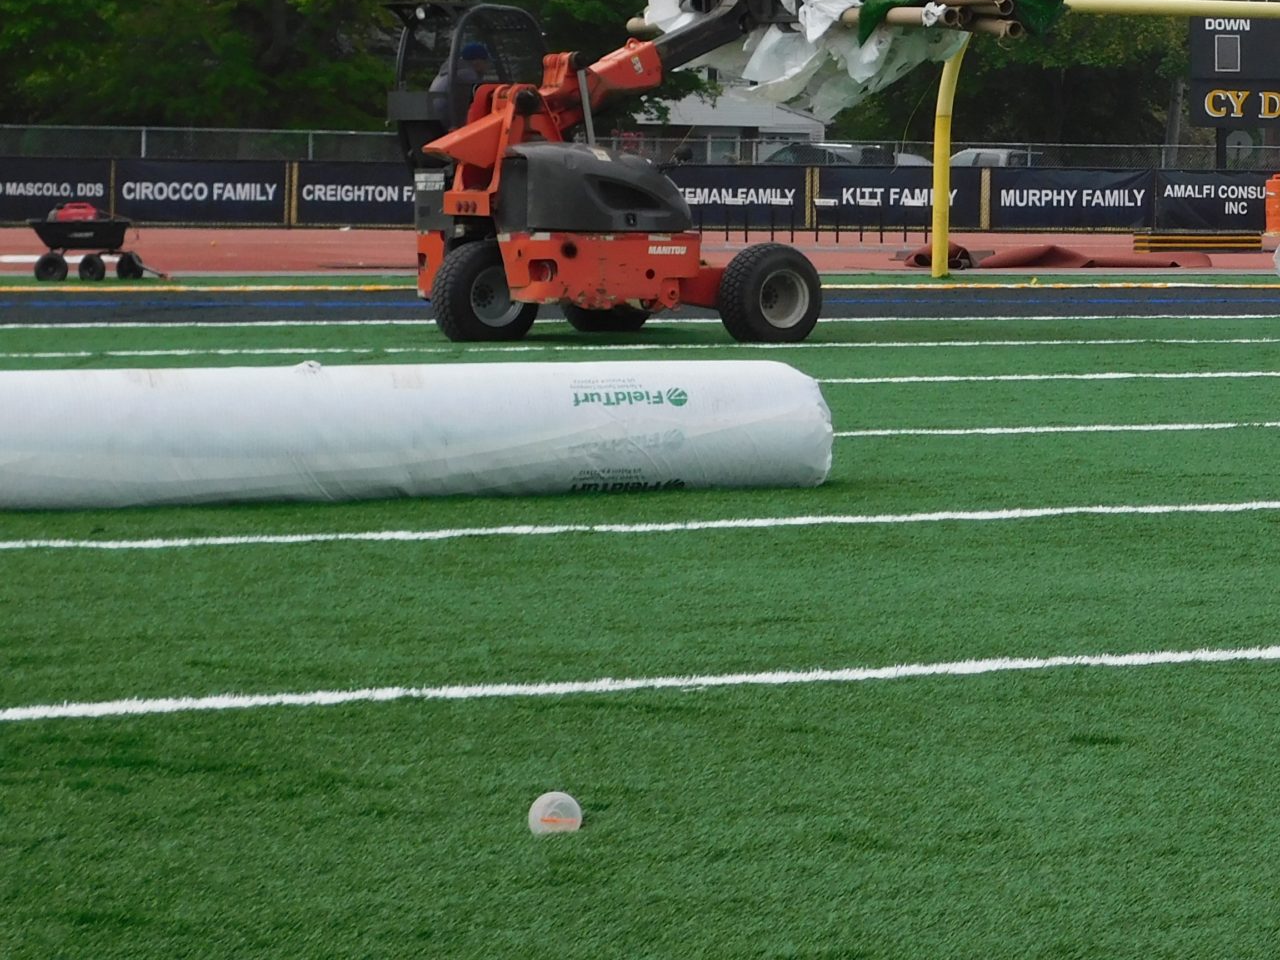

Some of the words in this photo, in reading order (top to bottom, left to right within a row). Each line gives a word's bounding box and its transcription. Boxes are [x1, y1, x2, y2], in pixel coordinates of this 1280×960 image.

[1204, 18, 1251, 31] DOWN
[1204, 90, 1250, 118] CY
[5, 182, 74, 198] MASCOLO,
[77, 183, 104, 197] DDS
[122, 181, 208, 201] CIROCCO
[213, 182, 277, 201] FAMILY
[302, 184, 399, 202] CREIGHTON
[737, 188, 796, 205] FAMILY
[842, 187, 885, 205] KITT
[889, 188, 958, 206] FAMIY
[1001, 189, 1077, 207] MURPHY
[1082, 189, 1146, 207] FAMILY
[1163, 184, 1215, 198] AMALFI
[1225, 202, 1248, 215] INC
[648, 245, 687, 255] MANITOU
[573, 390, 664, 407] FieldTurf
